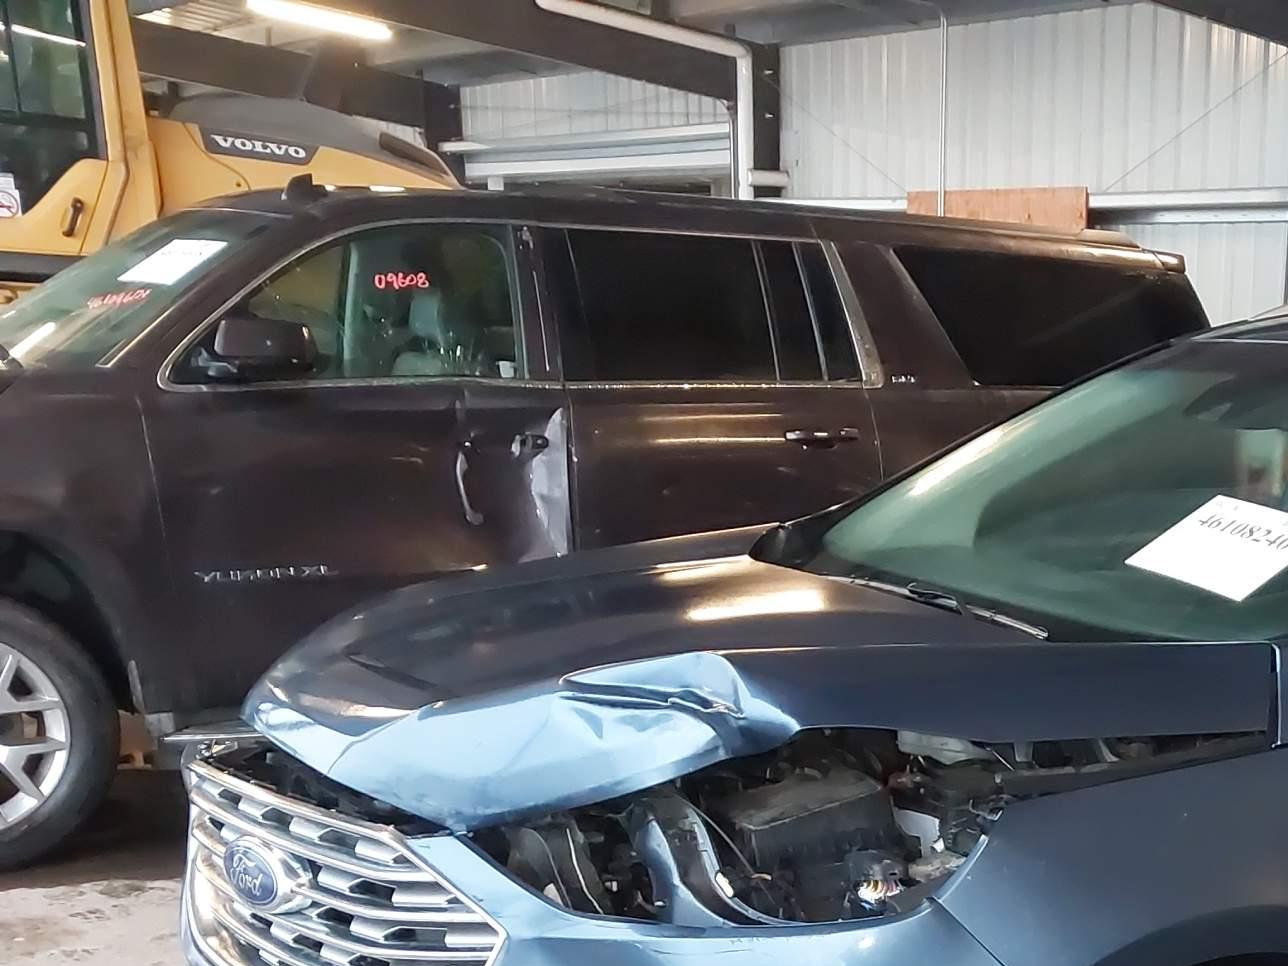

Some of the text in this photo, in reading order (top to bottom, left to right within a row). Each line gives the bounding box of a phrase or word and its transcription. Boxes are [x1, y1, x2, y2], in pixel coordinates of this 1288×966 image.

[210, 134, 307, 159] VOLVO
[374, 271, 430, 290] 09608
[229, 852, 264, 897] Ford
